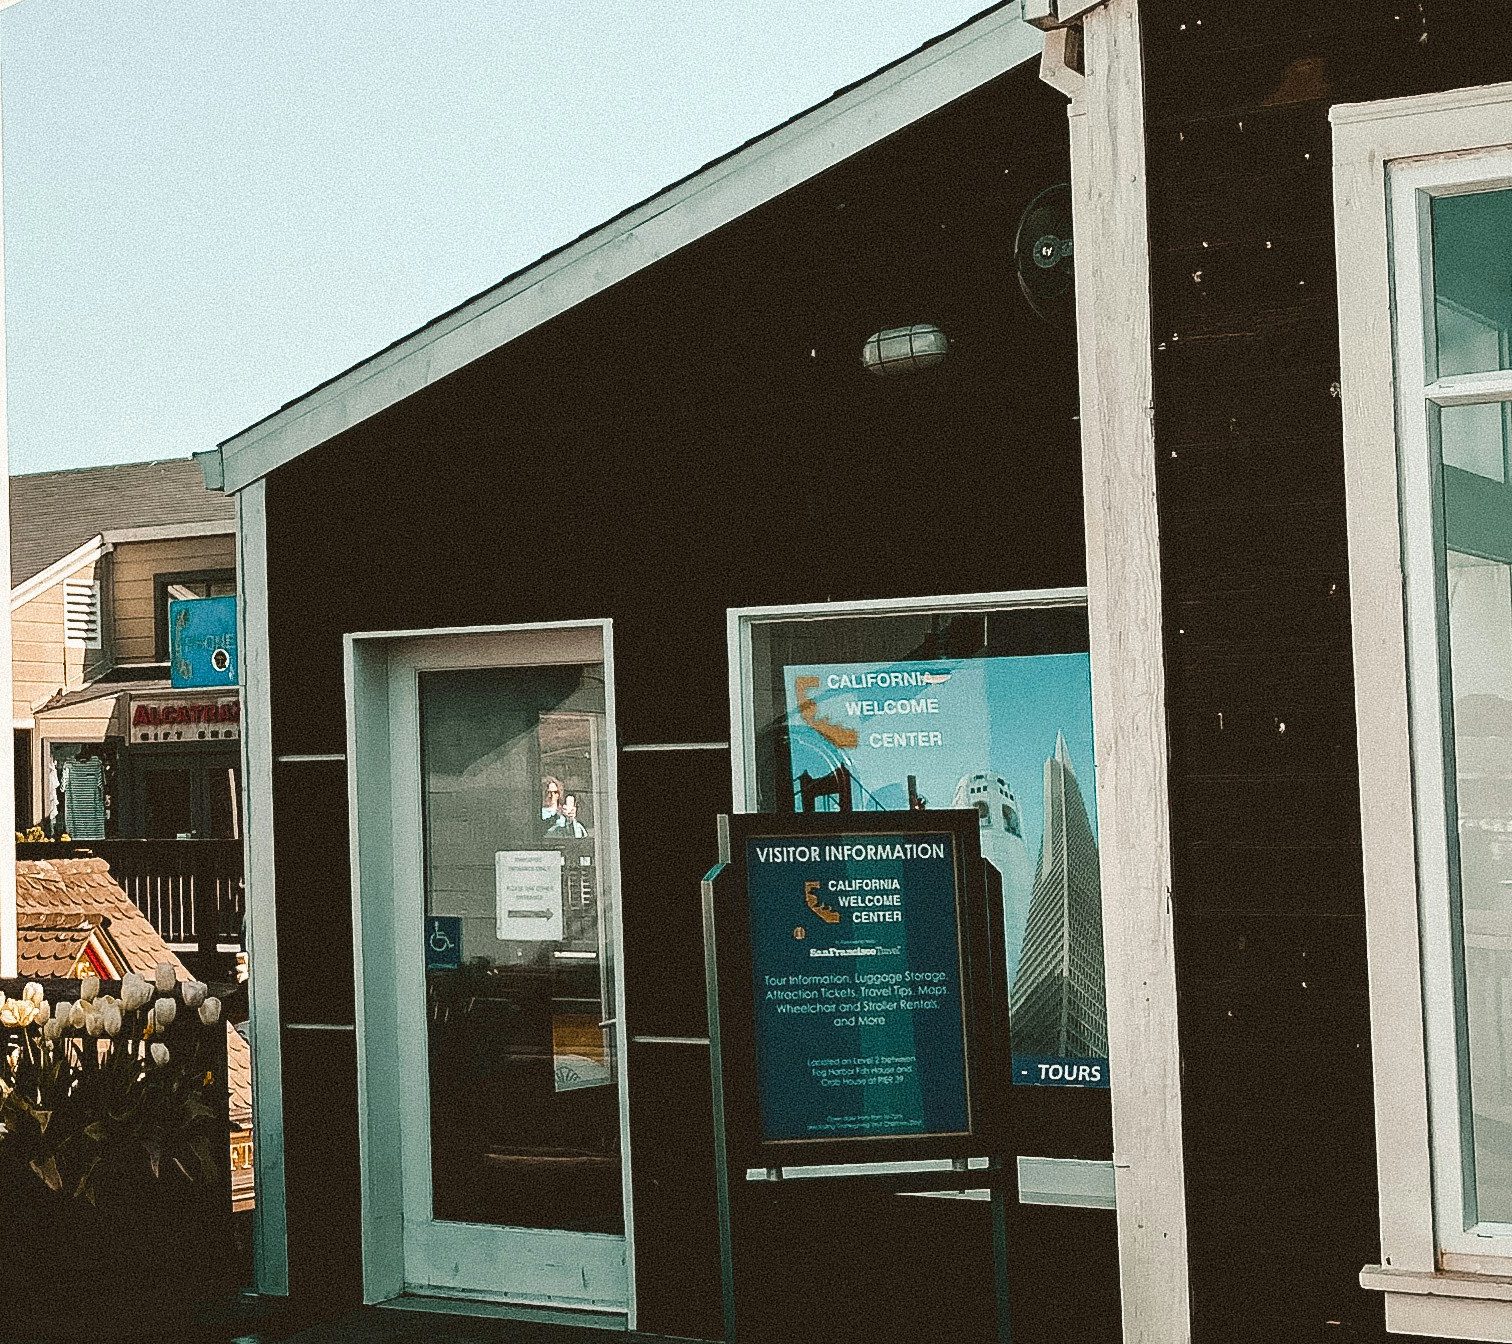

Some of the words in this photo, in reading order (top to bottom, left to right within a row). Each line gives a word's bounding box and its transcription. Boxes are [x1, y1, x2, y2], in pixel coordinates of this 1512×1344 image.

[827, 670, 933, 689] CALIFORNIA
[845, 698, 939, 716] WELCOME
[869, 731, 943, 748] CENTER
[756, 845, 821, 863] VISITOR
[825, 842, 945, 862] INFORMATION
[828, 878, 900, 892] CALIFORNIA
[838, 894, 902, 907] WELCOME
[852, 910, 902, 923] CENTER
[765, 975, 787, 986] Tour
[855, 973, 902, 985] Luggage
[765, 989, 819, 1000] Attraction
[860, 986, 892, 997] Travel
[776, 1002, 836, 1014] Wheelchair
[838, 1002, 861, 1012] and
[863, 1000, 897, 1012] Stroller
[833, 1016, 855, 1027] and
[858, 1016, 886, 1026] More
[1037, 1064, 1101, 1082] TOURS
